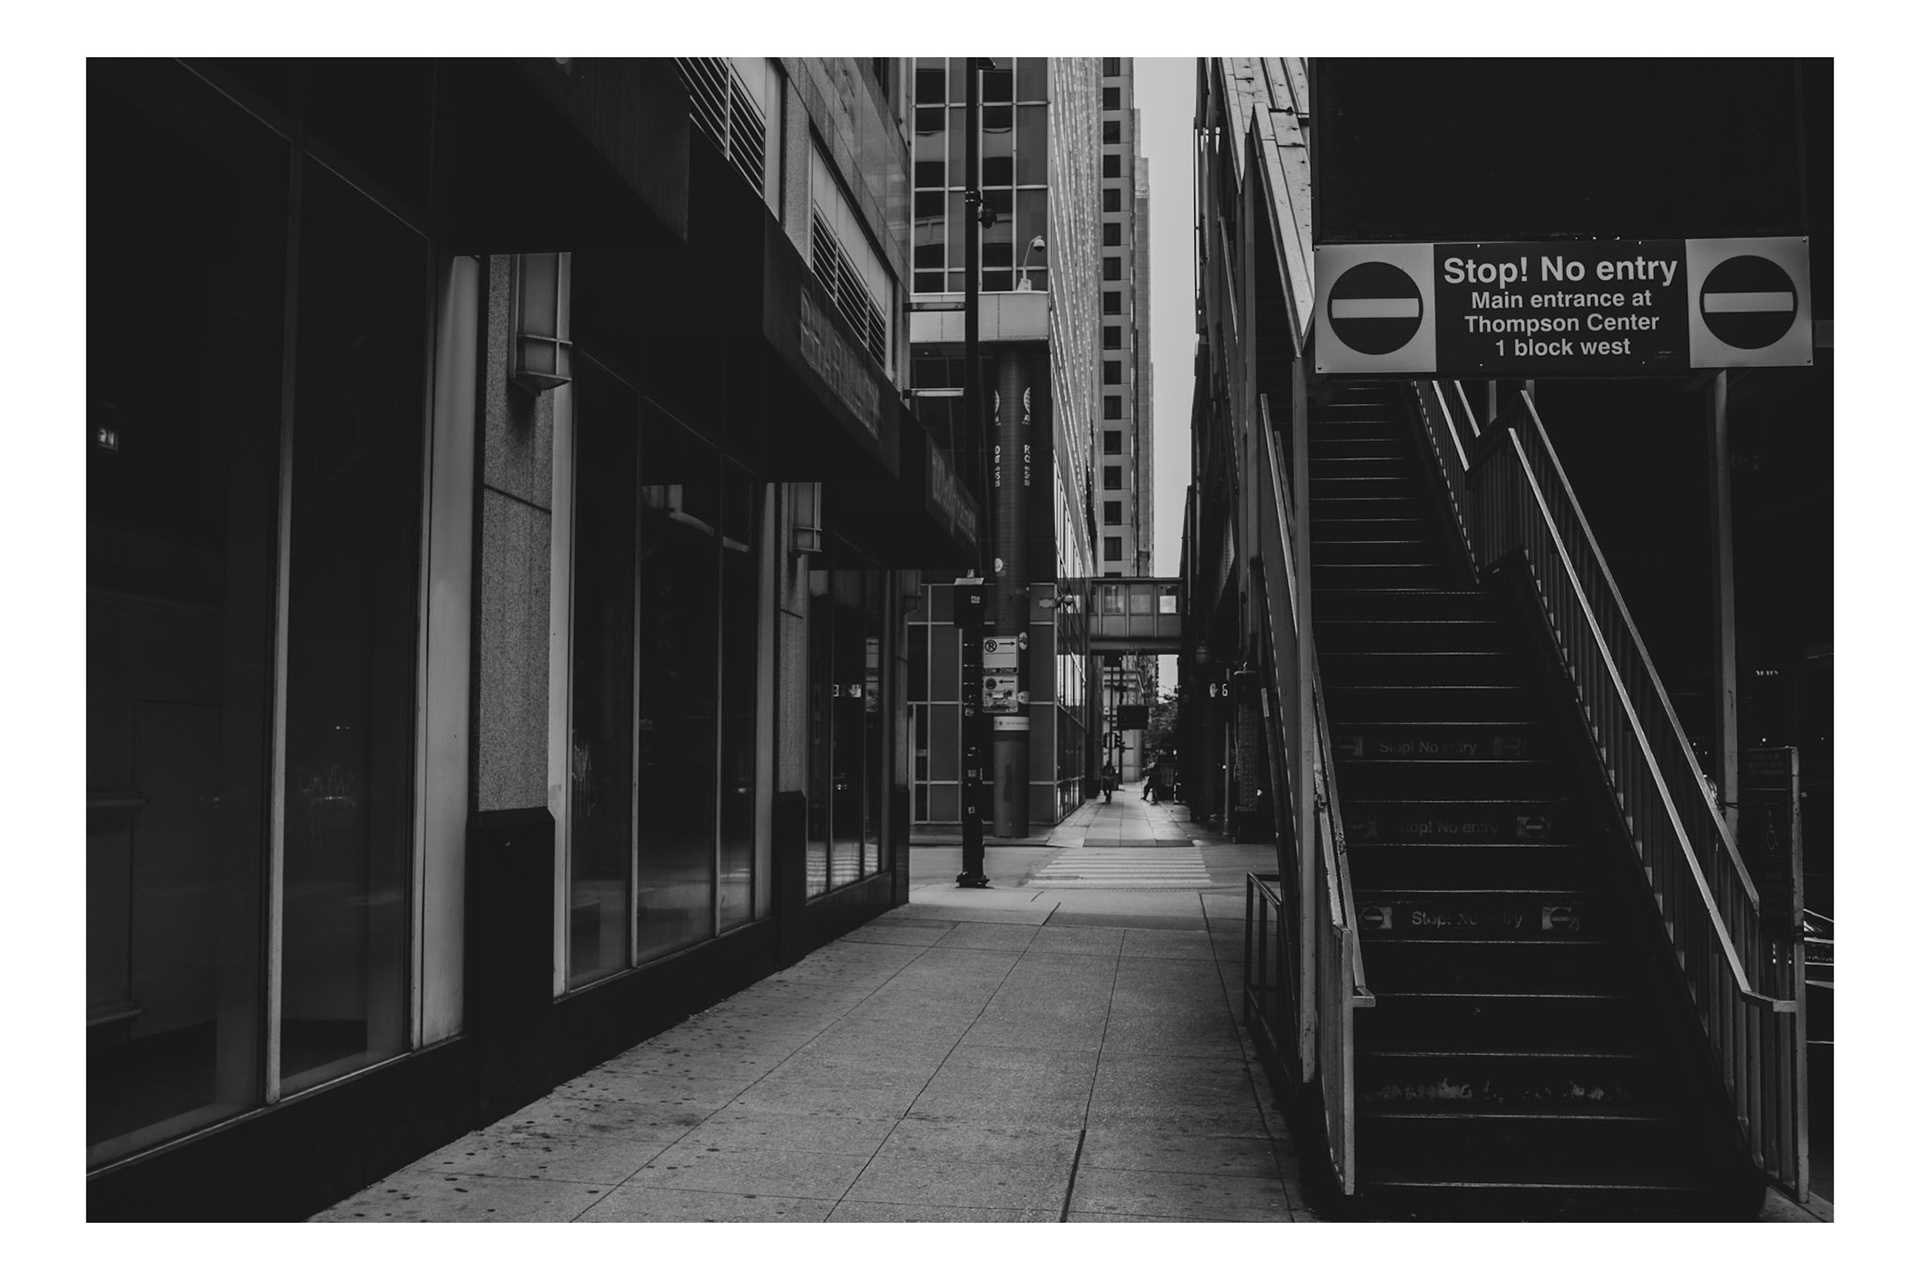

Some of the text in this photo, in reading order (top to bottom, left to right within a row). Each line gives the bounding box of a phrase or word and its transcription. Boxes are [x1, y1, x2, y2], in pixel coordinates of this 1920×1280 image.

[1443, 255, 1678, 289] Stop! No entry
[1471, 289, 1652, 309] Main entrance at
[1464, 313, 1660, 336] Thompson Center
[1495, 337, 1631, 357] 1 block west
[1222, 683, 1228, 697] 6
[1419, 740, 1439, 753] No
